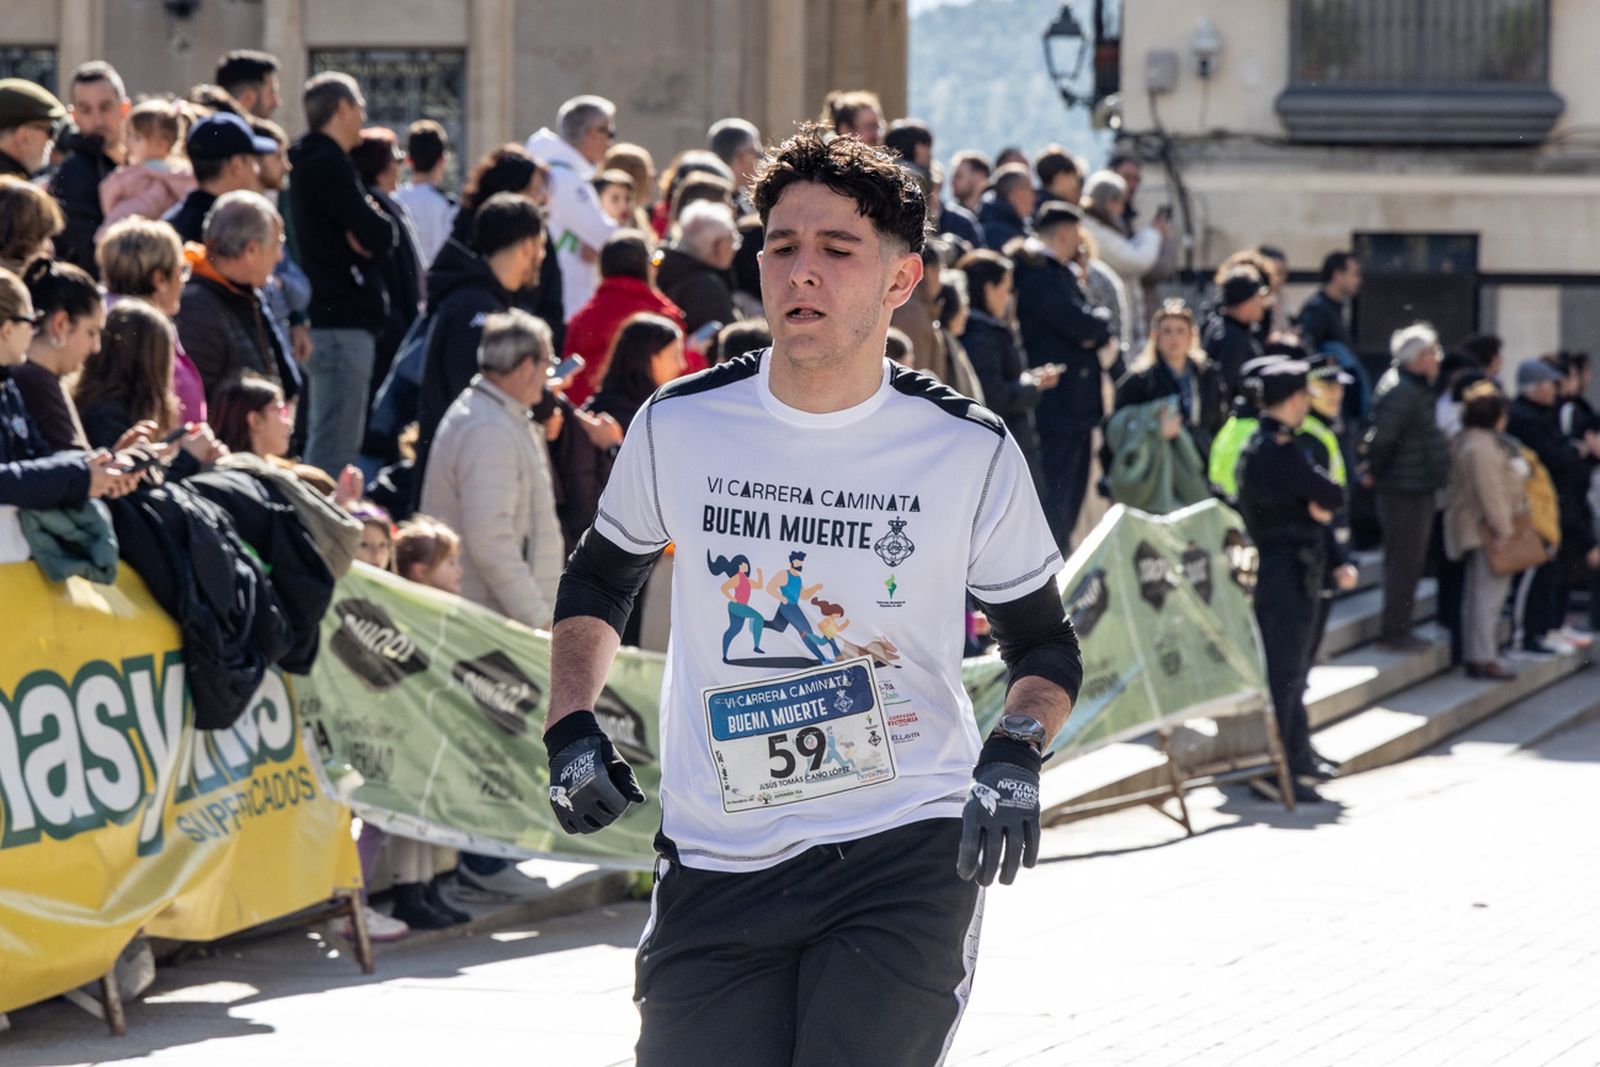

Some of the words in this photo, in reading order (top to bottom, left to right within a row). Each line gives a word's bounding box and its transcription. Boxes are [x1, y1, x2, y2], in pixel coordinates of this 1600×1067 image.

[706, 476, 722, 494] VI
[727, 480, 814, 505] CARRERA
[820, 490, 921, 513] CAMINATA
[702, 504, 771, 540] BUENA
[779, 514, 873, 550] MUERTE
[737, 688, 787, 708] CARRERA
[789, 674, 850, 698] CAMINATA
[727, 710, 769, 734] BUENA
[771, 698, 828, 725] MUERTE
[887, 716, 919, 727] VICTORIA
[572, 759, 594, 782] SAN
[767, 726, 827, 780] 59
[779, 775, 804, 787] TOMÁS
